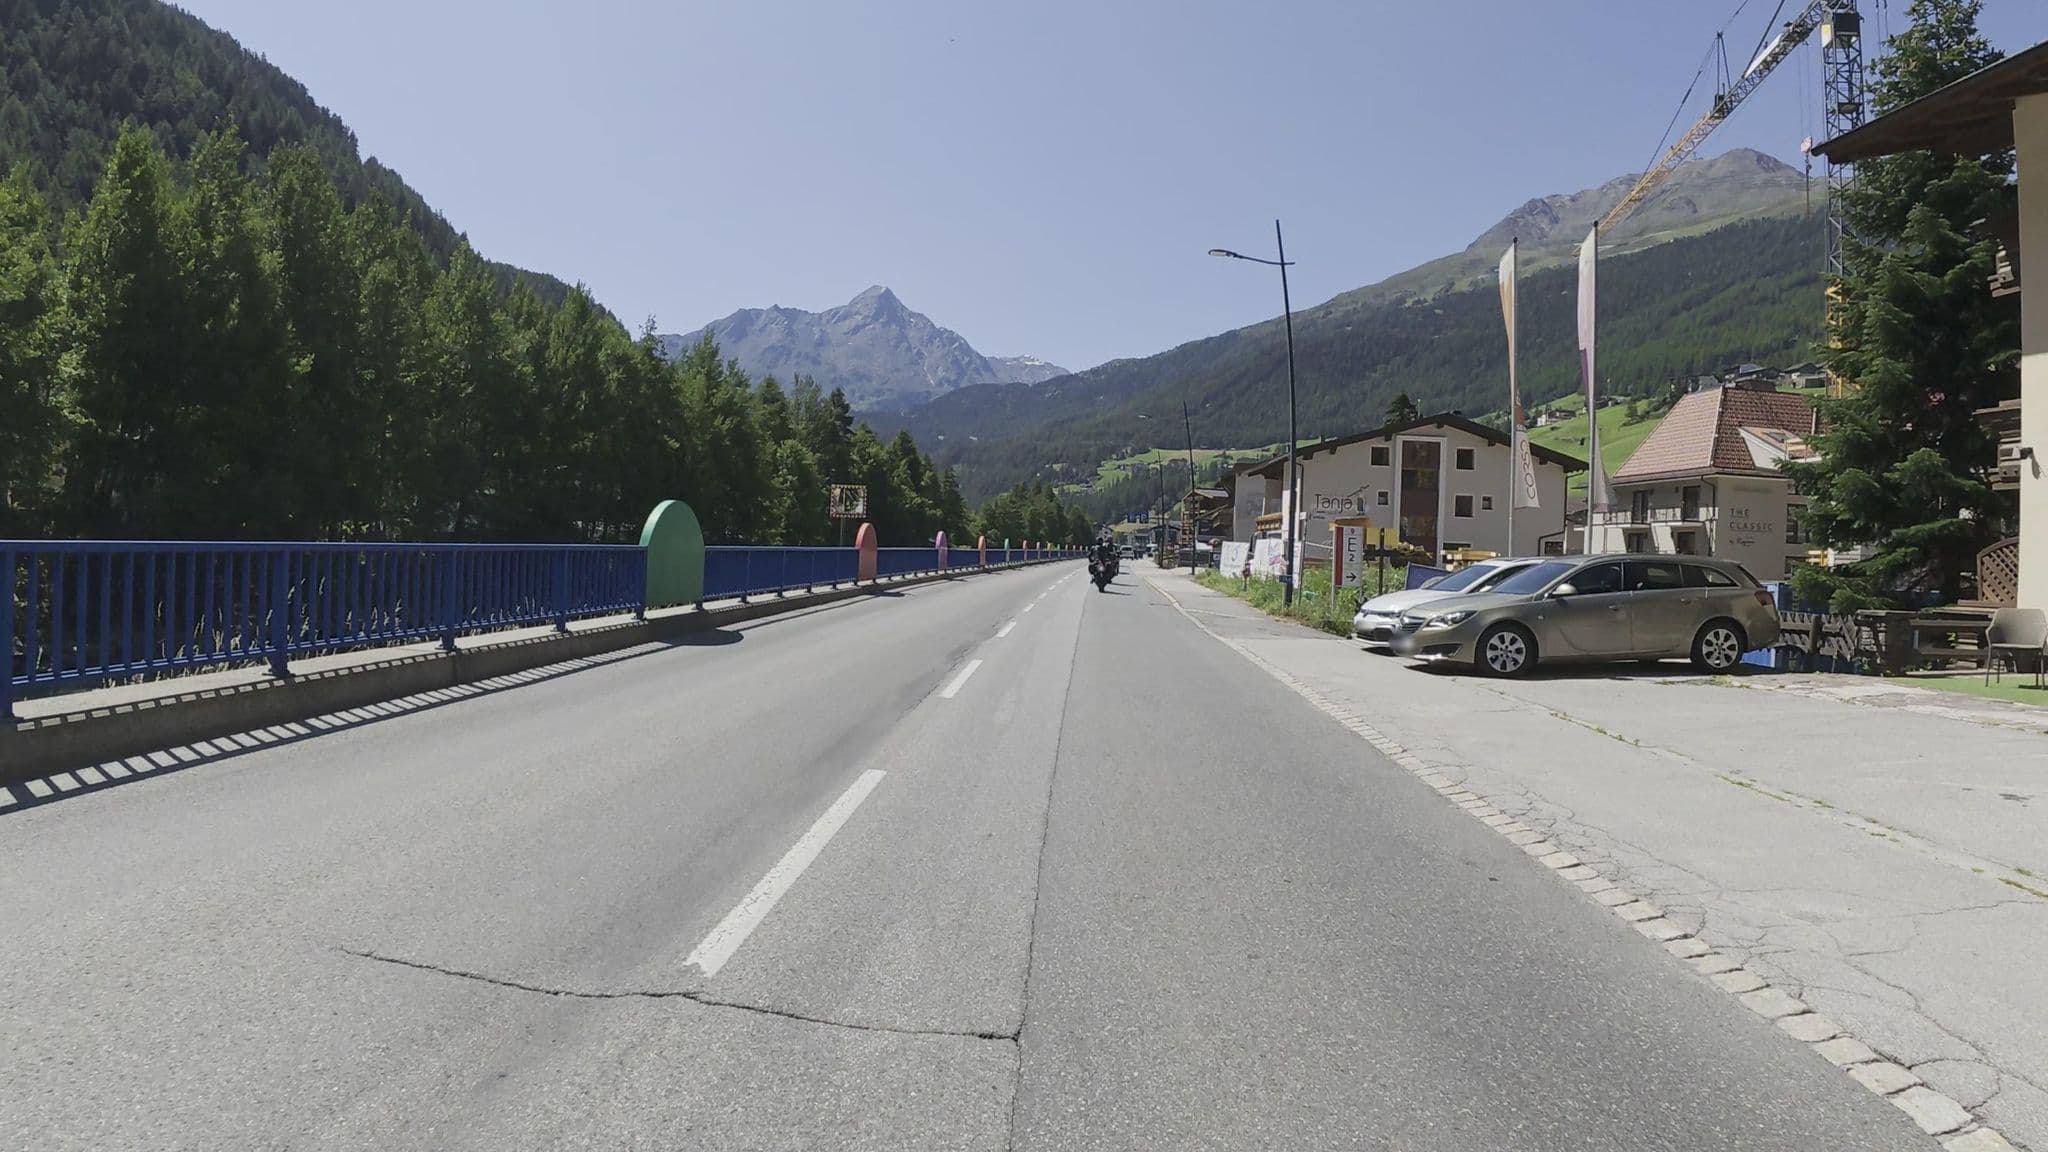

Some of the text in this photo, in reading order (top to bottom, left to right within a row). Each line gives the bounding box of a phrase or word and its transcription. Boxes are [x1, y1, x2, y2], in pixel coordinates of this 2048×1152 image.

[1314, 493, 1353, 514] Tanja
[1729, 508, 1750, 517] THE
[1729, 521, 1774, 530] CLASSIC
[1348, 537, 1358, 552] E
[1348, 553, 1356, 562] 2
